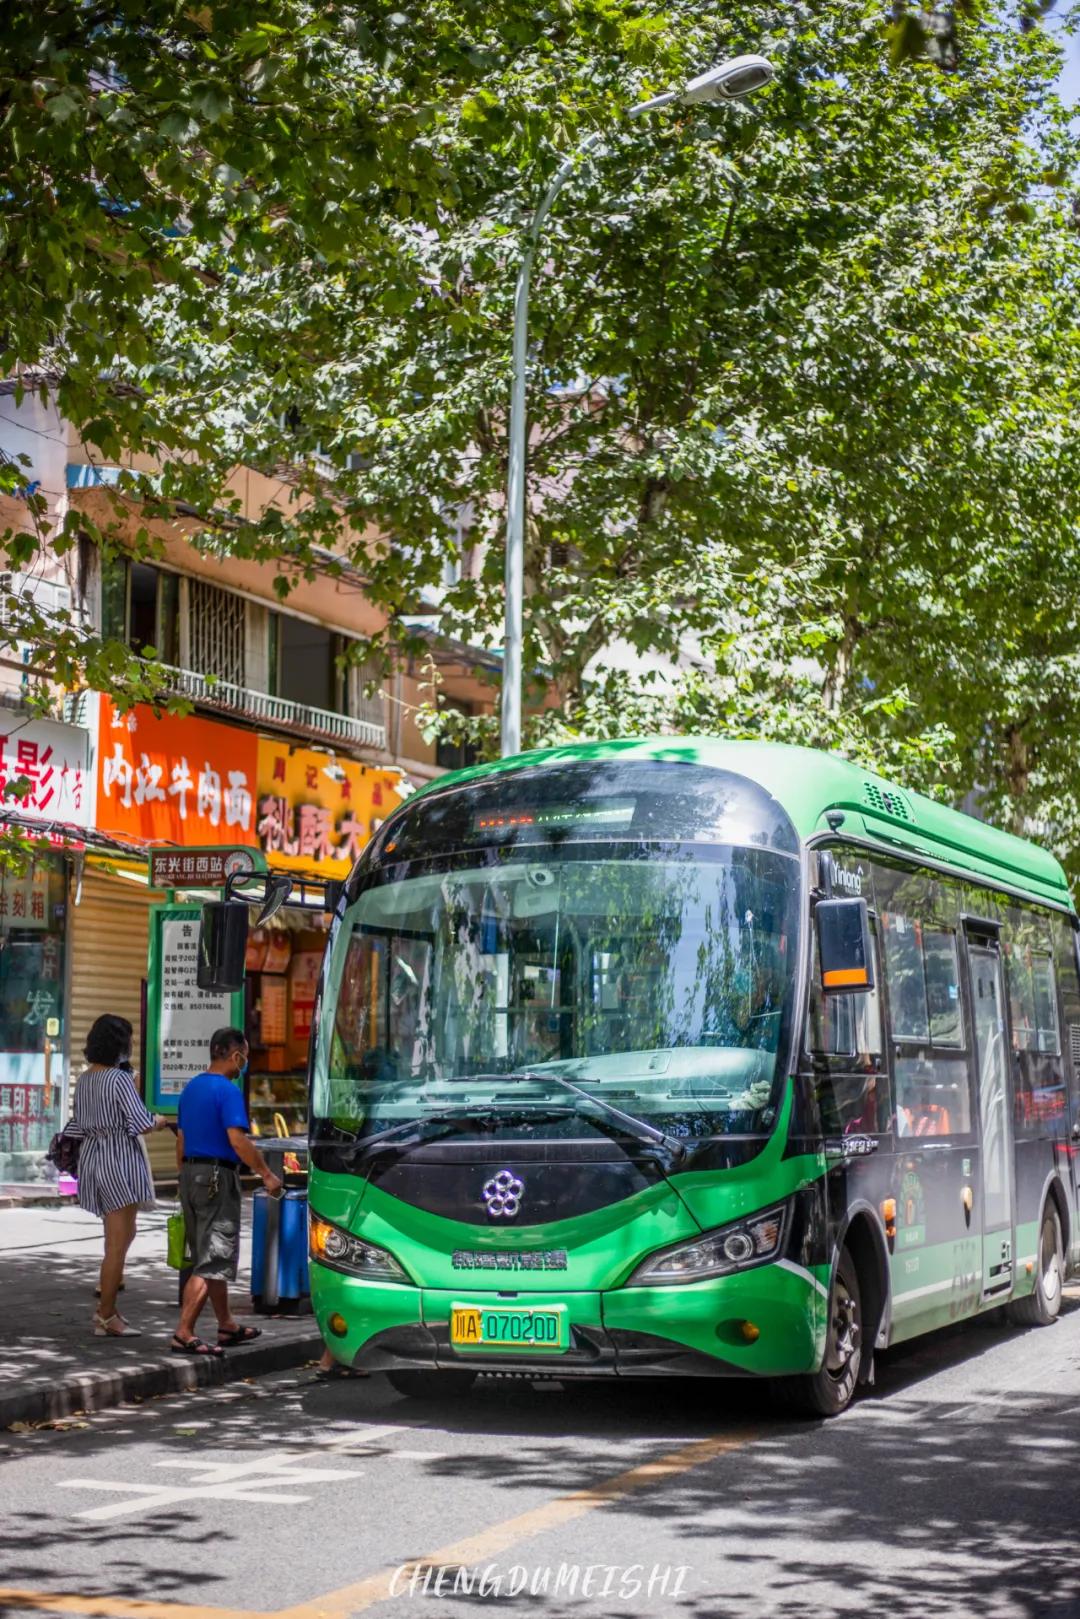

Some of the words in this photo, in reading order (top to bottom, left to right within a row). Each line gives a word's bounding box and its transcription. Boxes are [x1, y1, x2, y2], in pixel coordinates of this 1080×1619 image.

[104, 742, 252, 831] 内江牛肉面
[258, 794, 385, 863] 桃酥大
[155, 857, 223, 873] 东光街西站
[486, 1315, 558, 1341] 07020D
